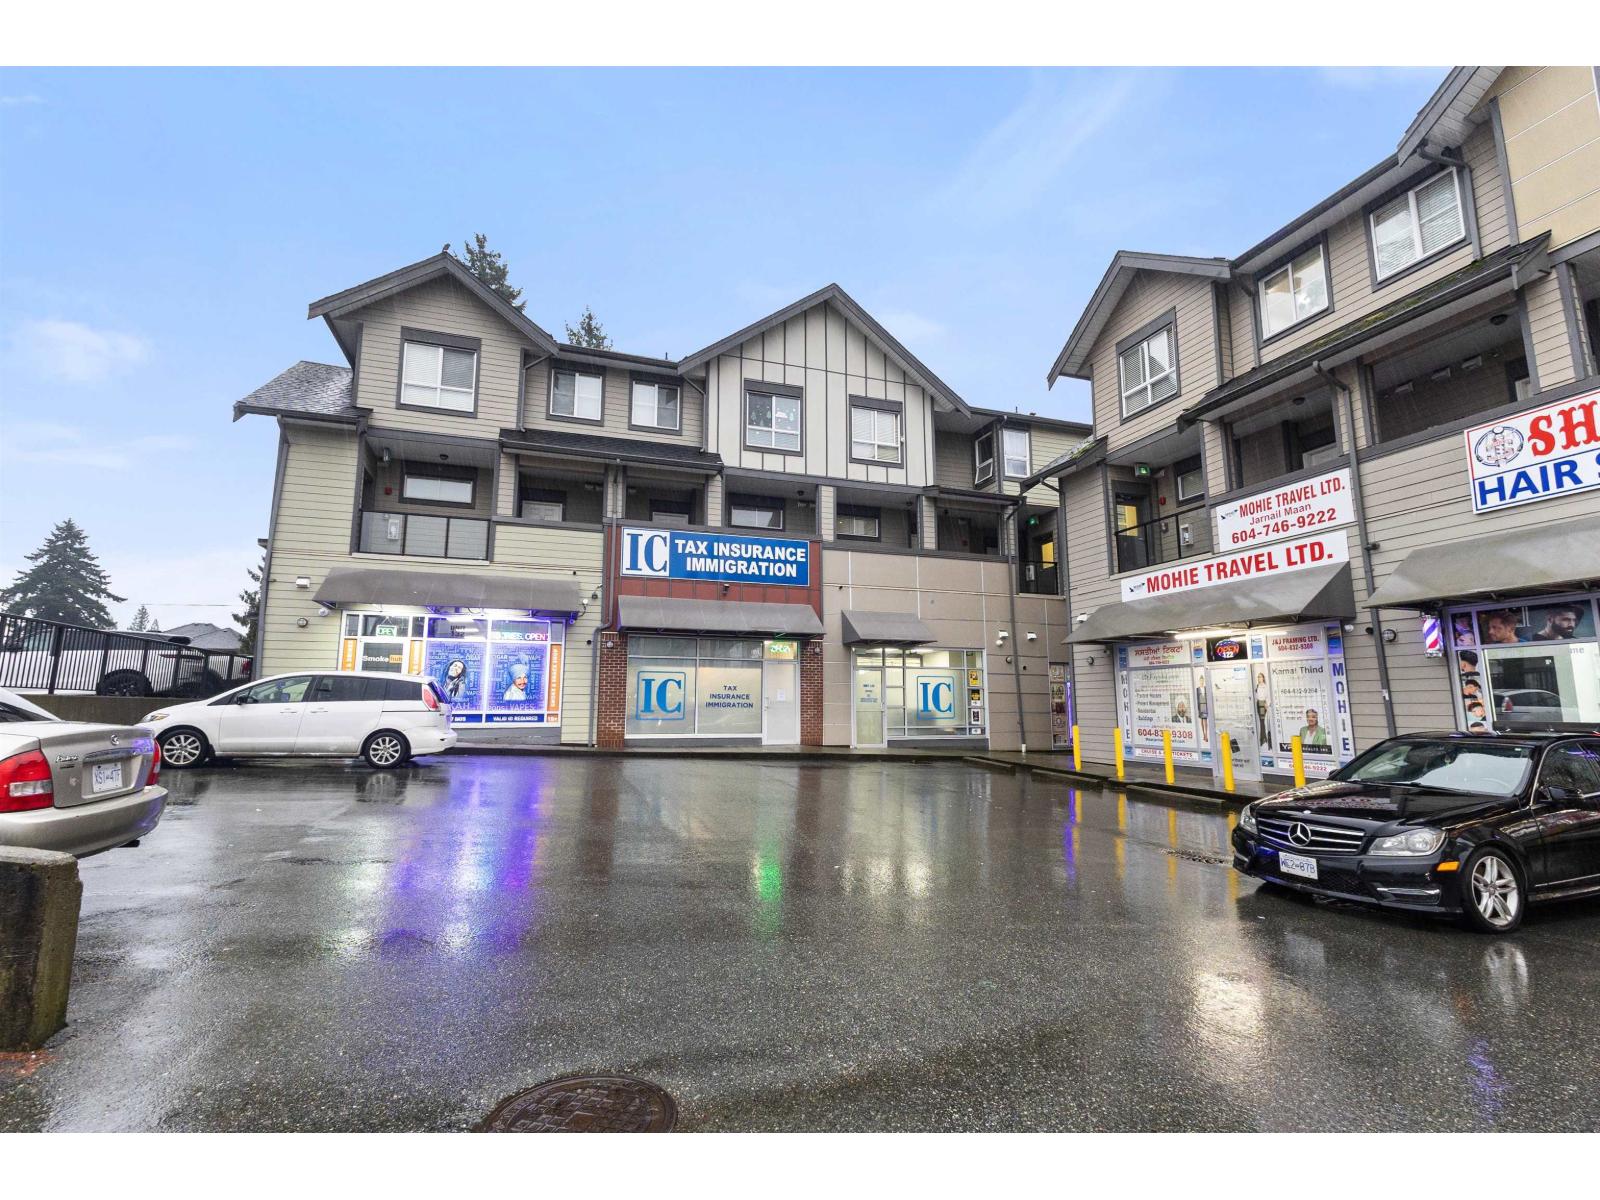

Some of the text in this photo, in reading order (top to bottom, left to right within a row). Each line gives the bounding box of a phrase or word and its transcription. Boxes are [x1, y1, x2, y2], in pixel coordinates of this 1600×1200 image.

[1478, 459, 1583, 506] HAIR
[1239, 496, 1272, 518] MOHIE
[1275, 485, 1317, 508] TRAVEL
[1320, 477, 1346, 496] LTD.
[1231, 507, 1337, 544] 604-746-9222
[1249, 509, 1282, 526] Jarnail
[1284, 503, 1312, 517] Maan
[625, 533, 668, 573] IC
[675, 539, 806, 562] TAX INSURANCE
[686, 557, 797, 577] IMMIGRATION
[1146, 541, 1333, 593] MOHIE TRAVEL LTD.
[525, 632, 546, 640] OPEN
[1282, 636, 1308, 644] FRAMING
[1216, 644, 1240, 653] OPEN
[1300, 666, 1324, 674] Thind
[640, 678, 682, 713] IC
[920, 682, 952, 713] IC
[1137, 729, 1193, 739] 604-839308
